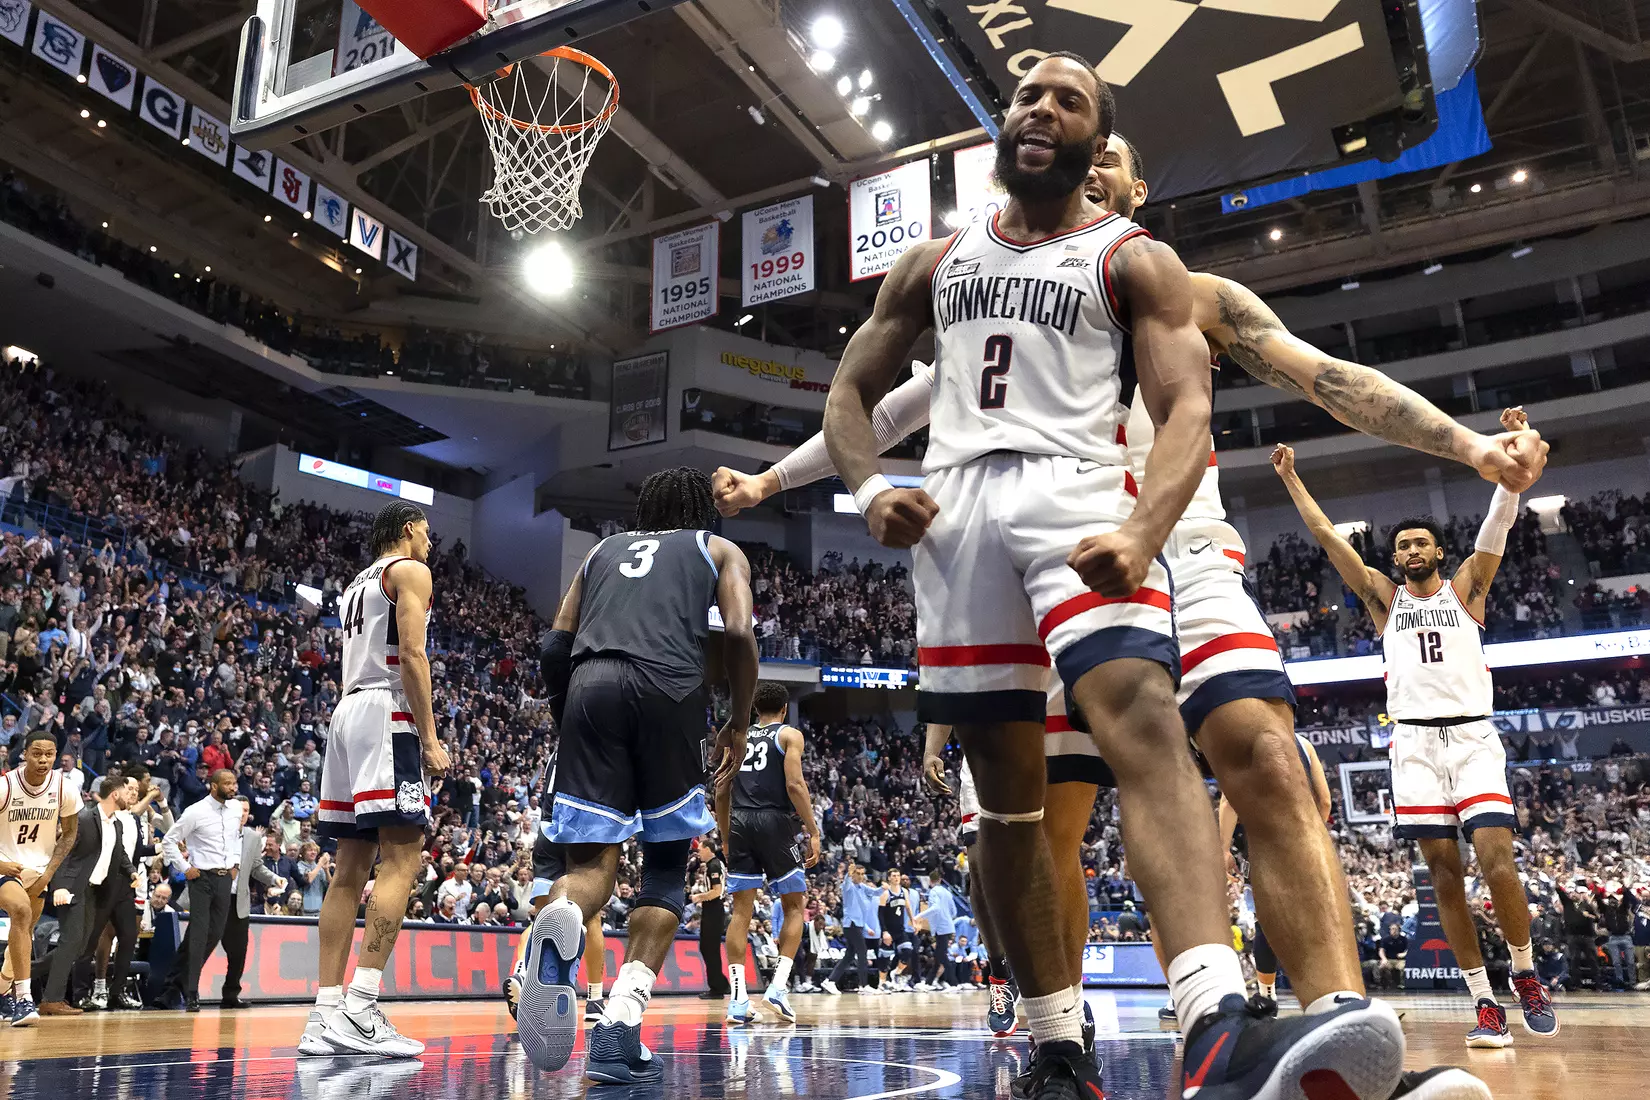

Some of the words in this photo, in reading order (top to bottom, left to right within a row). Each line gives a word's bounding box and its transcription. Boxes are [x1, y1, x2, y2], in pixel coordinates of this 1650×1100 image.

[344, 36, 395, 72] 201
[145, 88, 178, 131] G
[754, 206, 778, 217] UConn
[758, 208, 797, 224] Basketball
[356, 213, 381, 250] V
[658, 233, 680, 244] UConn
[668, 235, 704, 249] Basketball
[856, 221, 923, 254] 2000
[391, 236, 415, 275] X
[751, 251, 805, 280] 1999
[859, 259, 896, 275] CHAMP
[863, 245, 909, 263] NATIONA
[661, 276, 710, 305] 1995
[749, 282, 807, 304] CHAMPIONS
[753, 273, 803, 291] NATIONAL
[658, 307, 712, 327] CHAMPIONS
[662, 298, 708, 316] NATIONAL
[938, 276, 1087, 336] CONNECTICUT
[720, 351, 805, 381] megabus
[980, 334, 1013, 410] 2
[618, 538, 660, 579] 3
[344, 586, 366, 639] 44
[1395, 608, 1460, 633] CONNECTICUT
[1417, 631, 1444, 664] 12
[739, 740, 768, 772] 23
[1571, 762, 1593, 773] 122
[7, 807, 56, 823] CONNECTICUT
[17, 823, 40, 845] 24
